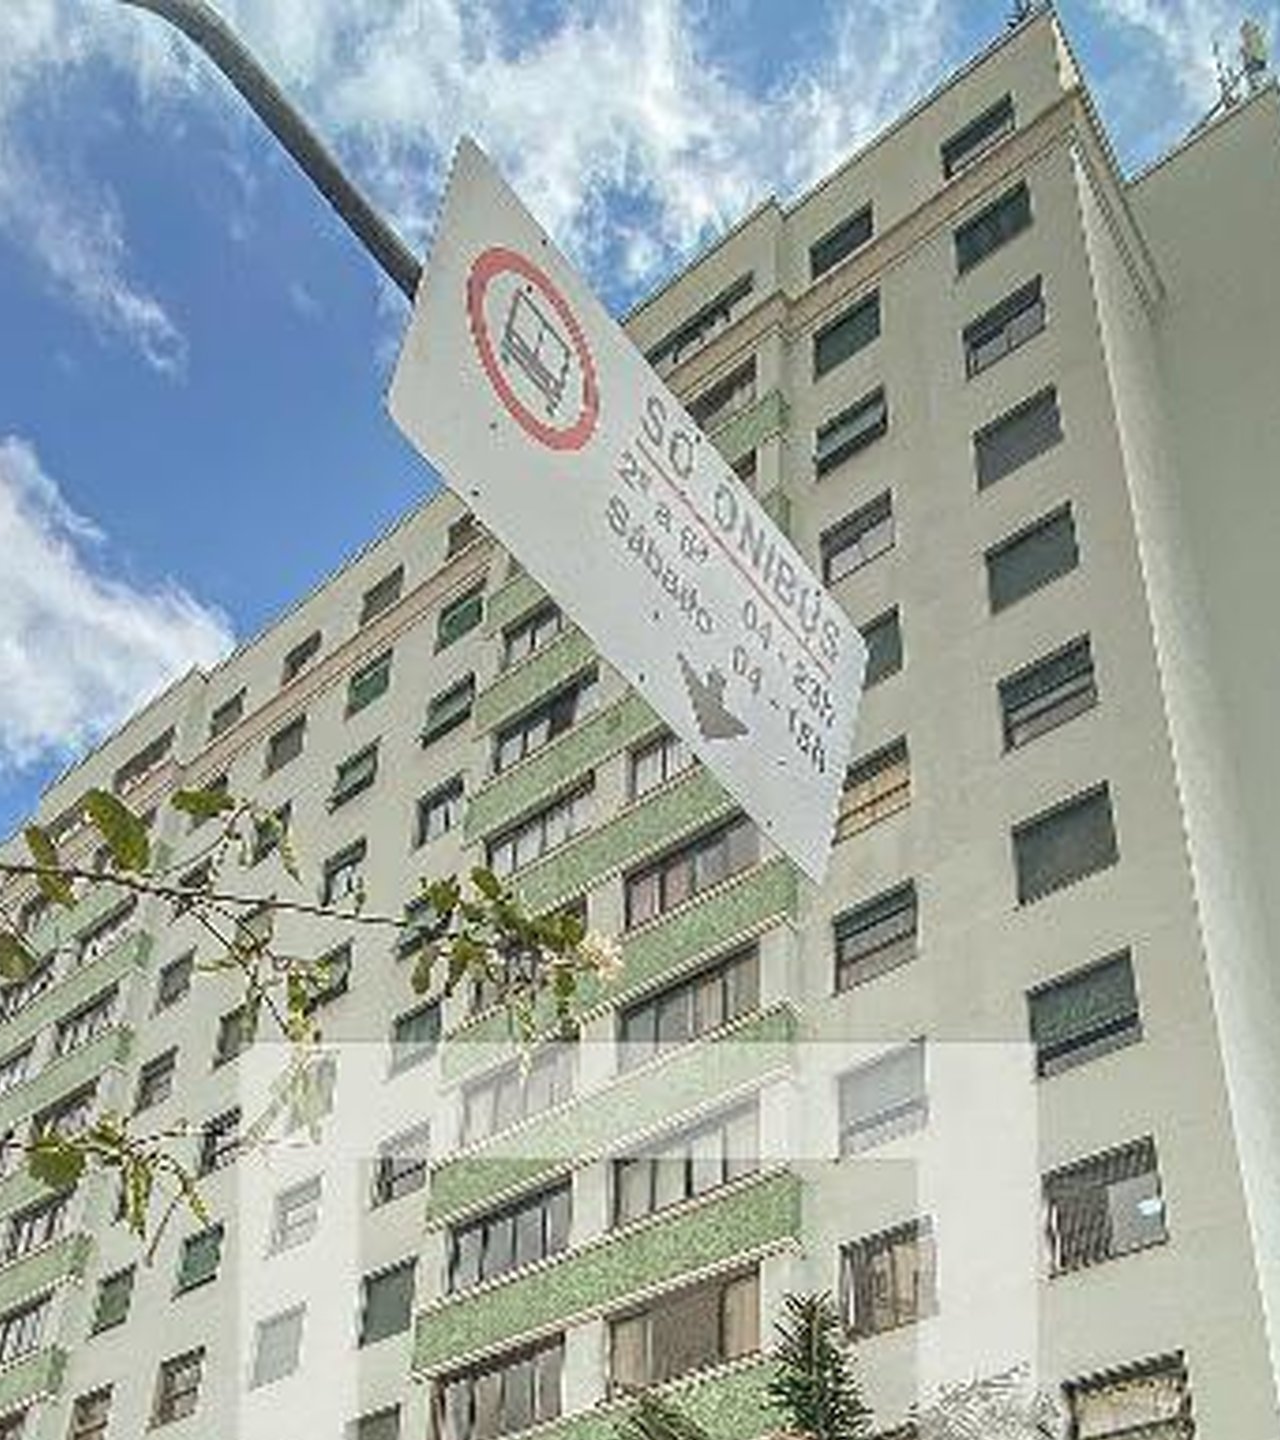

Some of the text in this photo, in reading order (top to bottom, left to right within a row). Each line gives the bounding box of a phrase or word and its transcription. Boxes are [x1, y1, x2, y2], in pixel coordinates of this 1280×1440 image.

[605, 495, 713, 635] Sábado
[732, 645, 762, 694] 04
[654, 501, 672, 534] a
[742, 600, 773, 651] 04
[713, 474, 840, 665] ÔNIBUS
